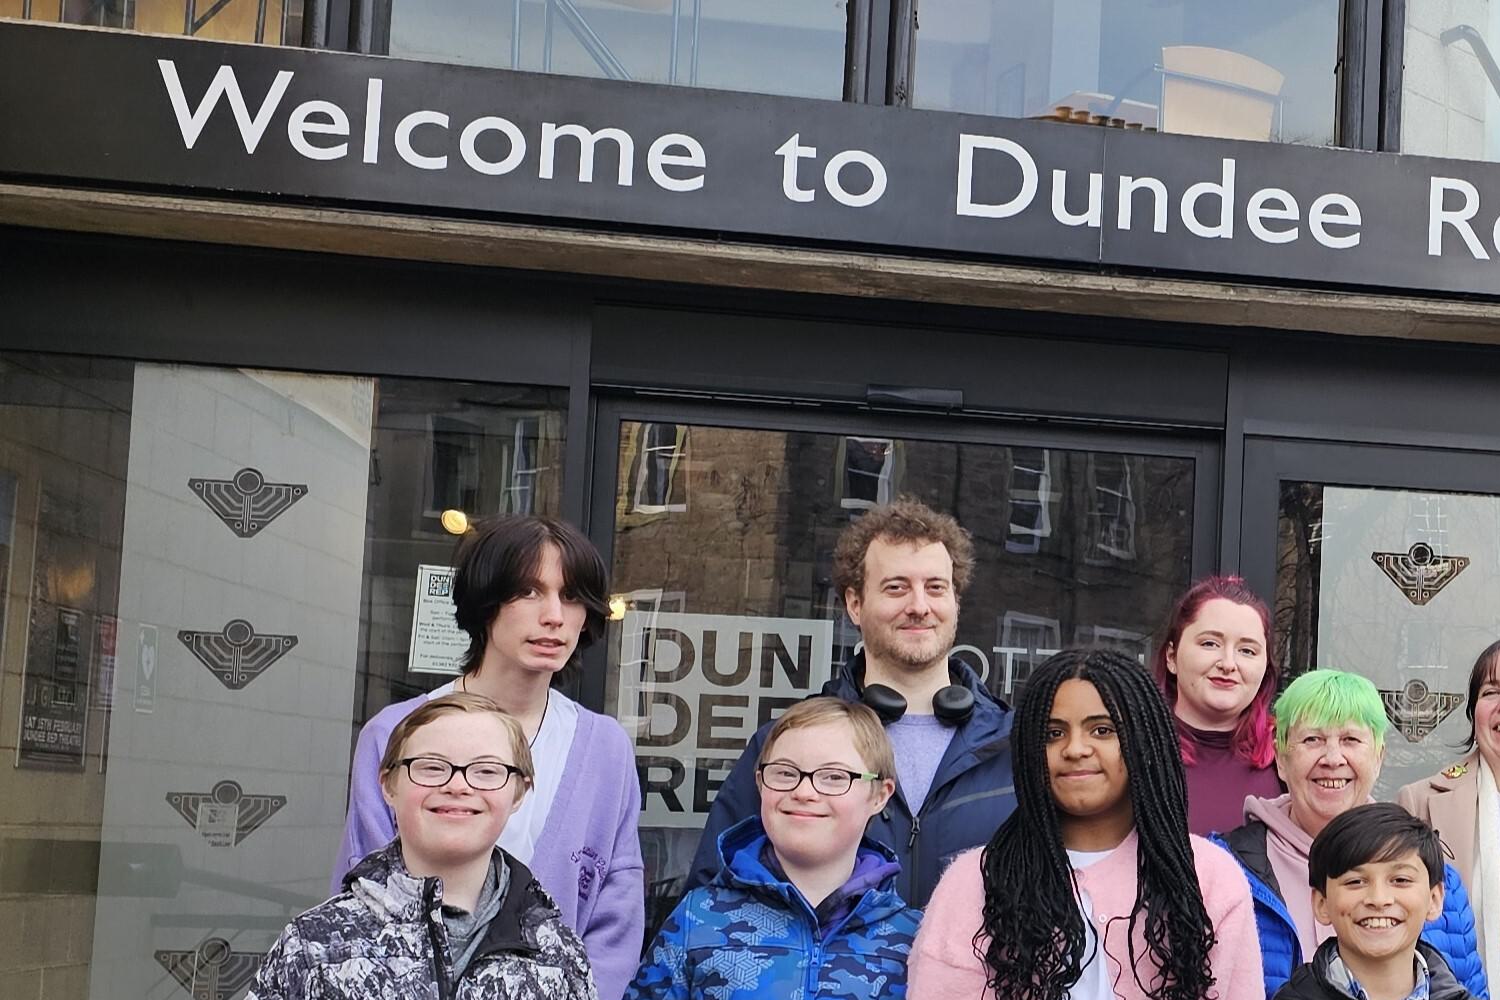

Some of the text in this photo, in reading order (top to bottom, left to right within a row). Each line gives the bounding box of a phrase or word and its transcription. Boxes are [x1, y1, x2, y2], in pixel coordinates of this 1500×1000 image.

[157, 58, 706, 192] Welcome
[775, 133, 887, 208] to
[955, 133, 1362, 249] Dundee
[430, 575, 450, 583] DUN
[640, 627, 812, 689] DUN
[636, 755, 738, 813] RE
